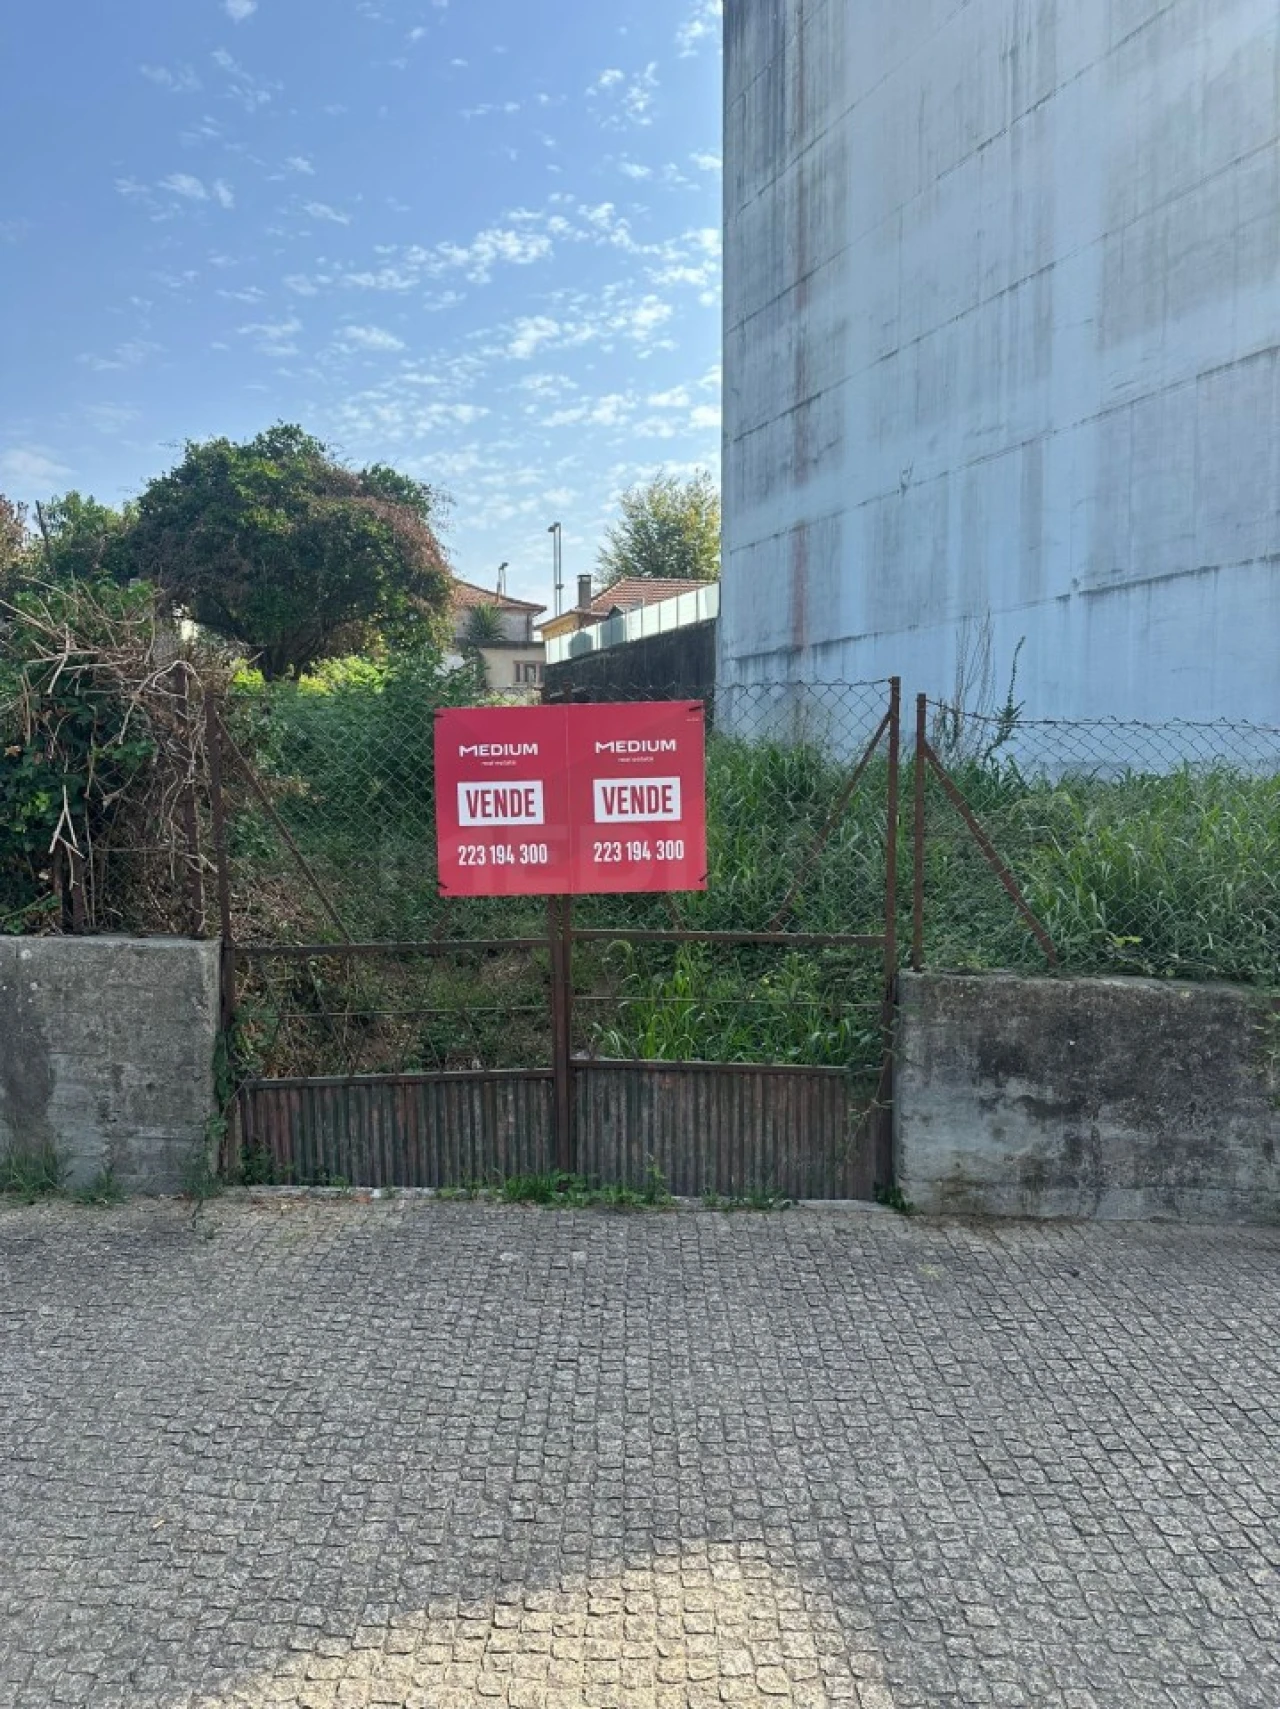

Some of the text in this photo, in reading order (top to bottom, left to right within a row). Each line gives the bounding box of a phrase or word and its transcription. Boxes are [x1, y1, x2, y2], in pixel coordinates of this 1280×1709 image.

[459, 743, 539, 757] MEDIUM
[595, 739, 676, 754] MEDIUM
[466, 789, 536, 819] VENDE
[602, 785, 673, 815] VENDE
[458, 843, 548, 865] 223 194 300
[593, 839, 684, 862] 223 194 300
